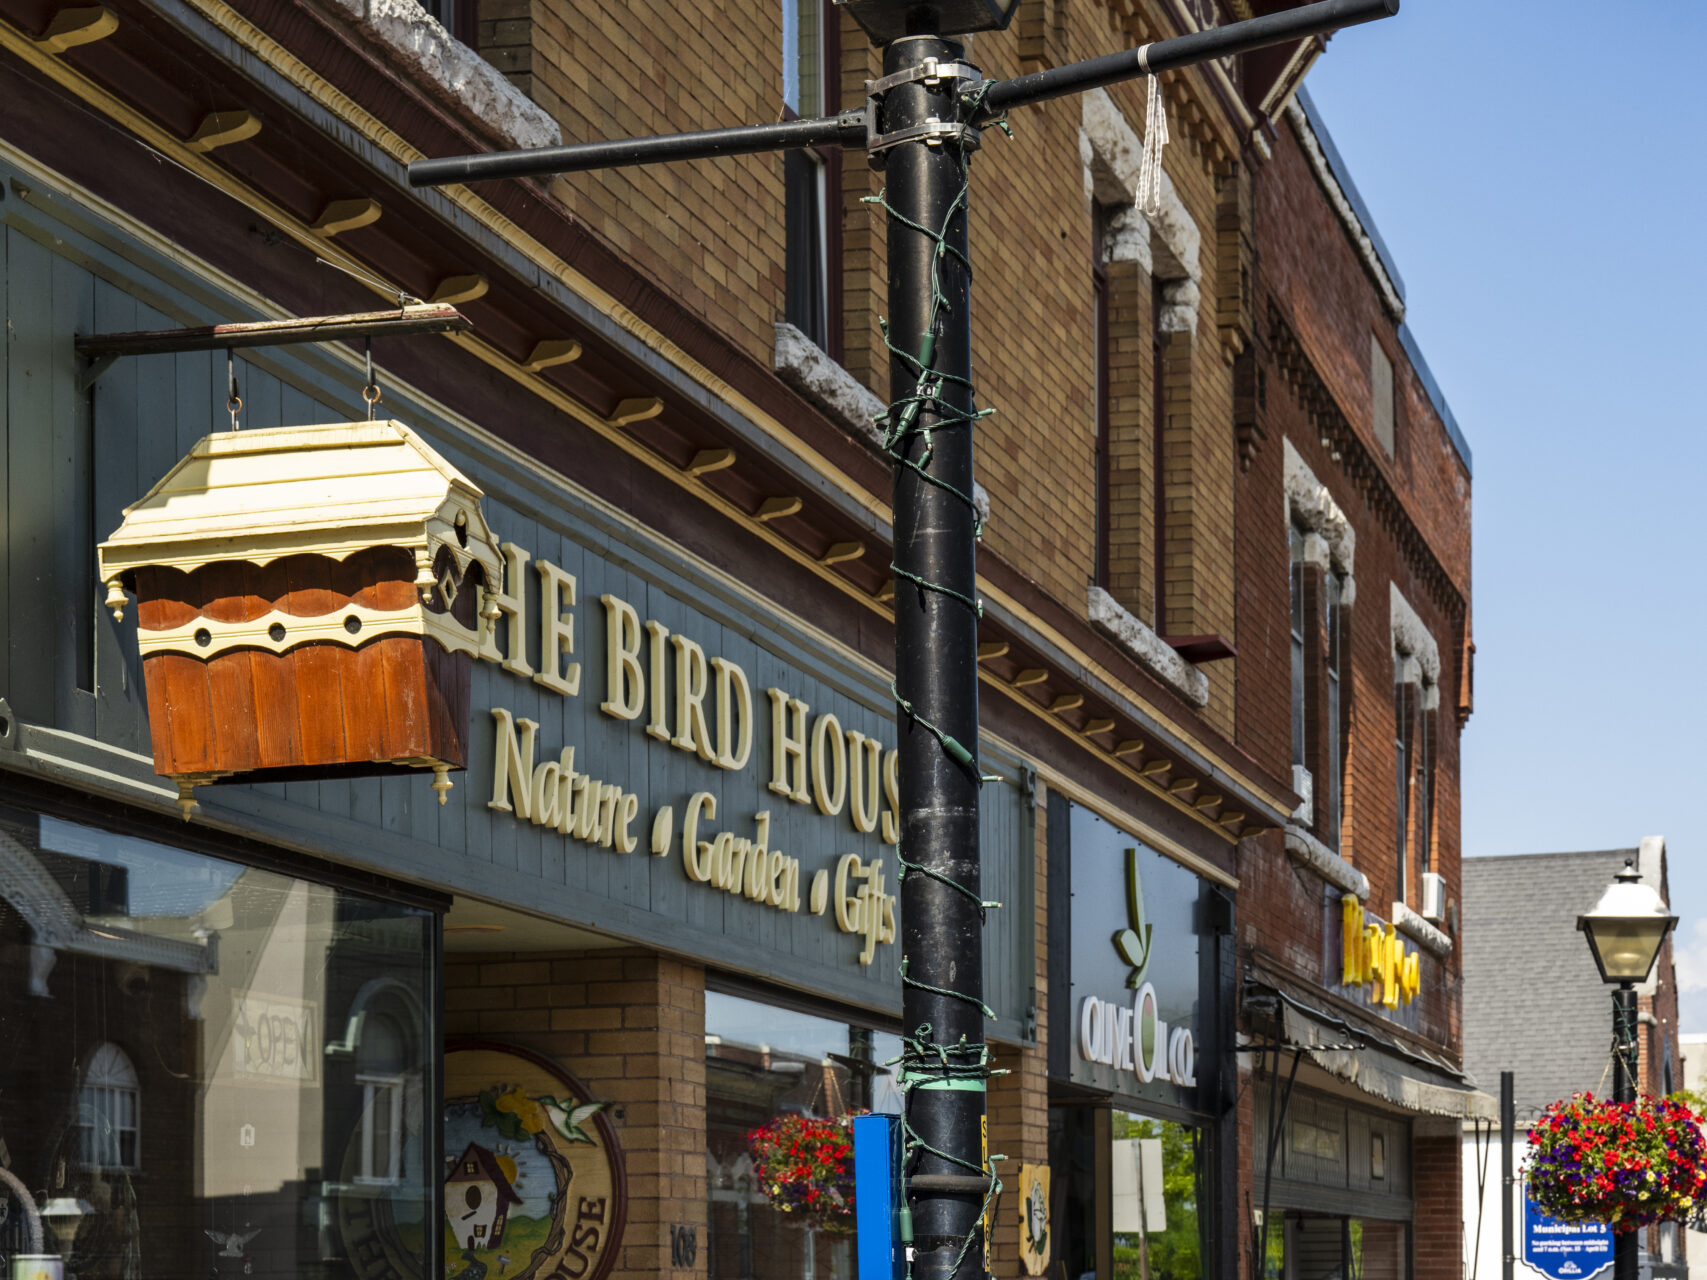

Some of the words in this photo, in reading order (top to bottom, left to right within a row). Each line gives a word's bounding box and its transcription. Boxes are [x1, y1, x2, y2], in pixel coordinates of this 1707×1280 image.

[600, 593, 754, 770] BIRD
[488, 708, 639, 854] Nature
[683, 791, 801, 912] Garden
[835, 853, 896, 966] Gifts
[257, 1012, 313, 1077] OPEN
[1081, 995, 1134, 1072] OLIVE
[1133, 981, 1171, 1084] OIL
[670, 1225, 697, 1268] 108
[1582, 1224, 1598, 1234] Lot
